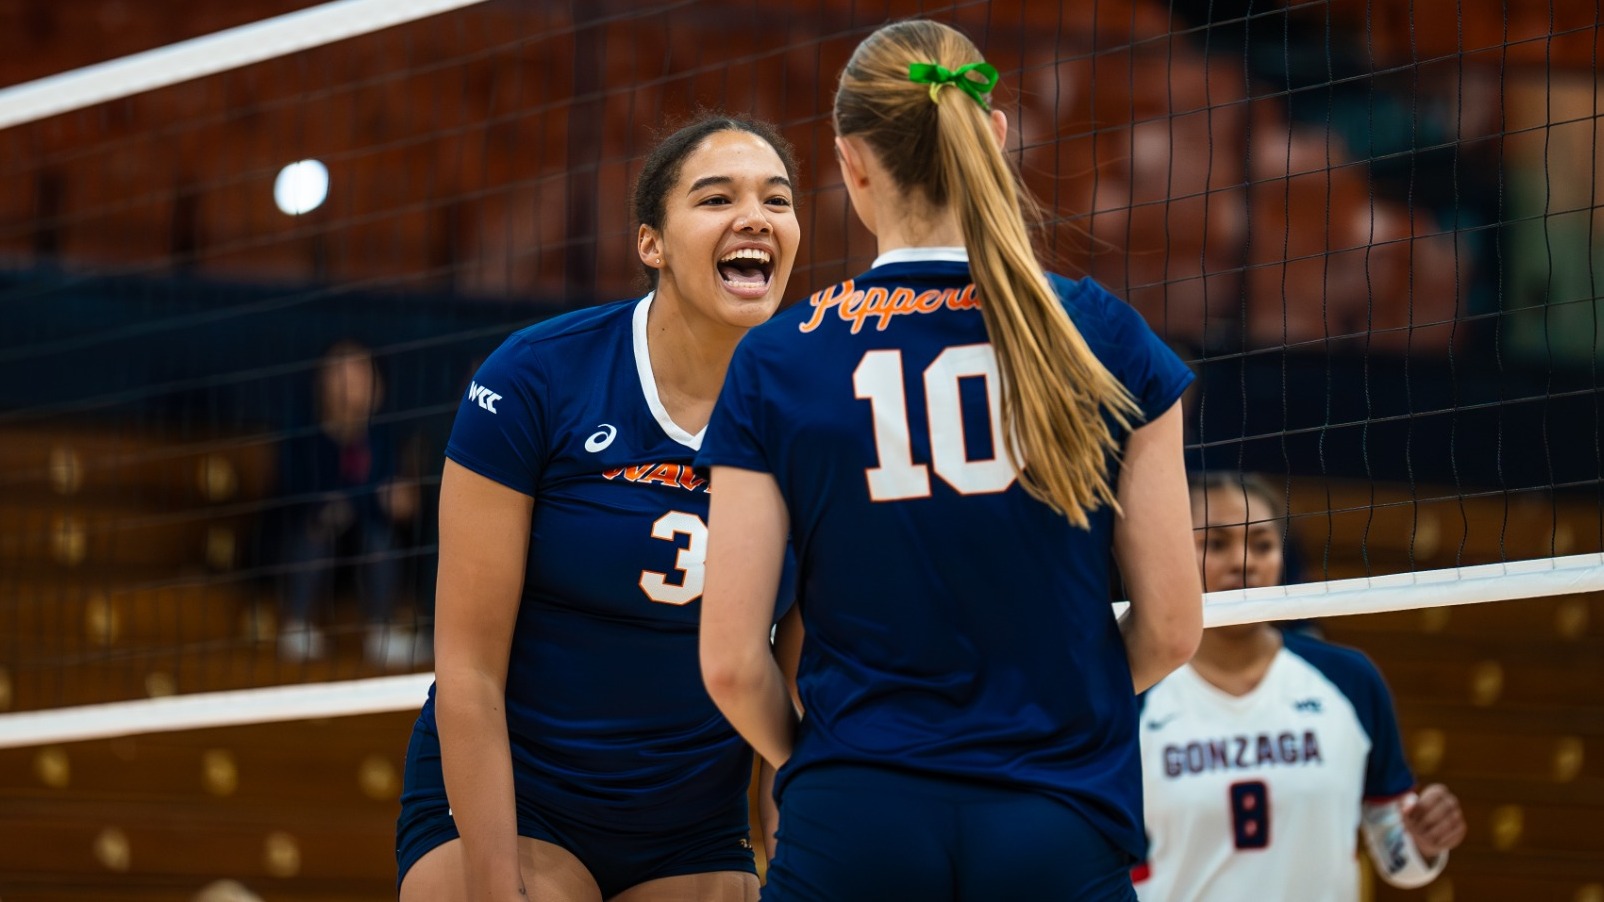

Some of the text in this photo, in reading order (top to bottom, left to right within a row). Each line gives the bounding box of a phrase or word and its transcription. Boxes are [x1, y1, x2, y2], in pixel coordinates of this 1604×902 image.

[468, 380, 502, 414] WCC
[852, 343, 1027, 502] 10
[602, 463, 711, 493] WAV
[638, 510, 708, 605] 3
[1163, 731, 1322, 777] GONZAGA
[1229, 780, 1270, 851] 8
